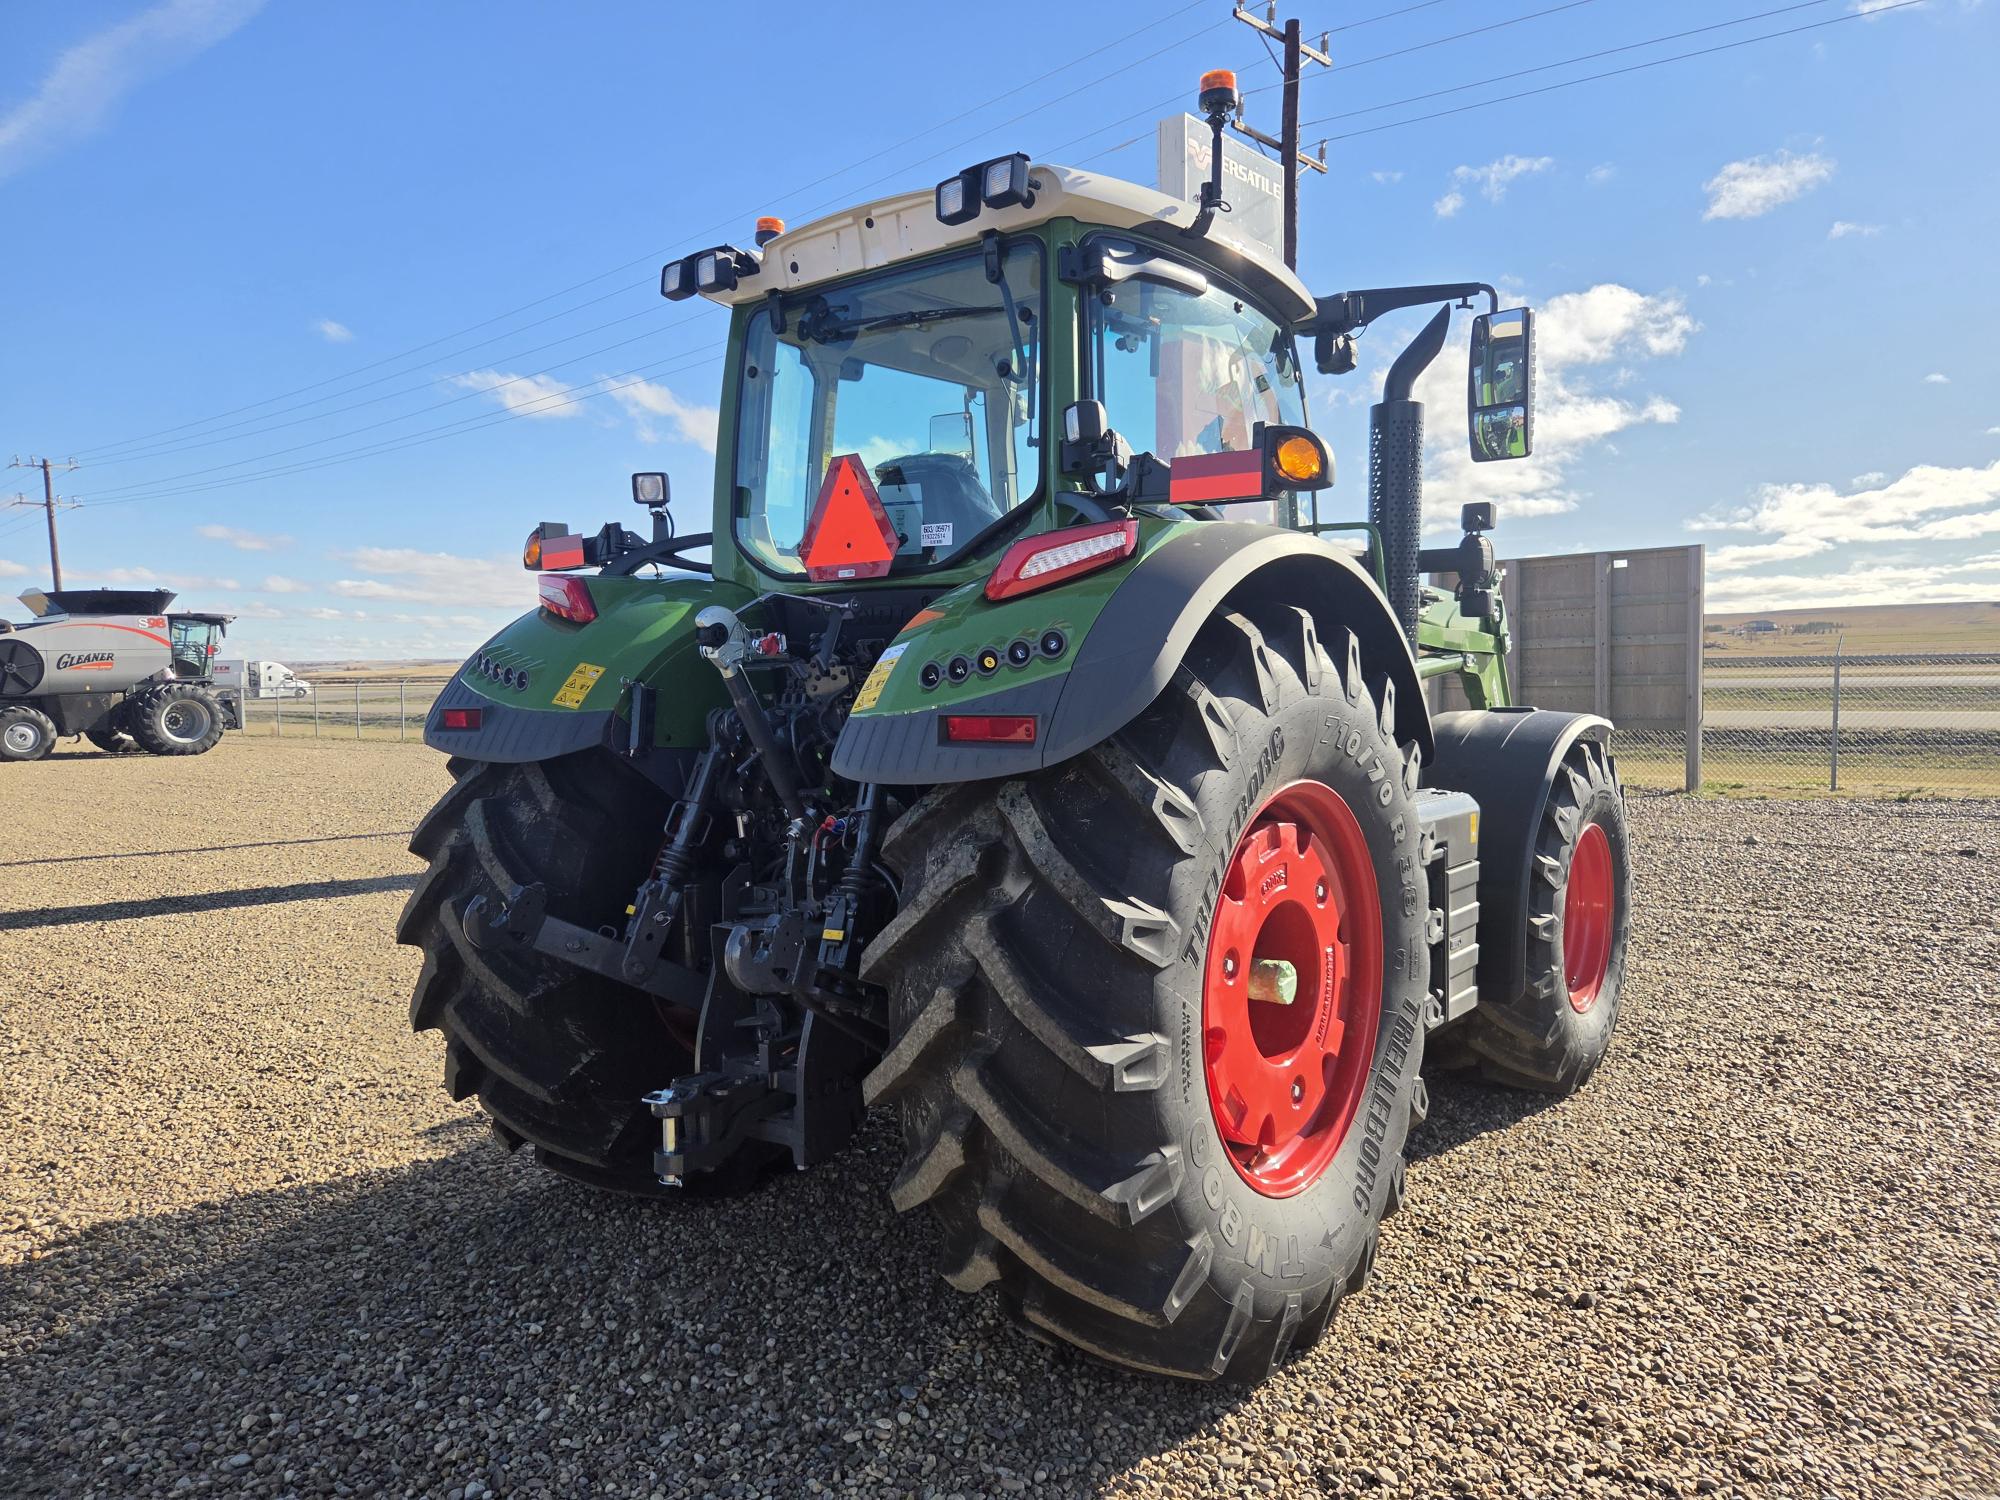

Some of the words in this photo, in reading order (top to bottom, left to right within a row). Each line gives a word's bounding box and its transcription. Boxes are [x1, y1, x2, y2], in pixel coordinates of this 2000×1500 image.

[1219, 154, 1281, 200] ERSATILE
[56, 652, 115, 670] GLEANER
[137, 616, 167, 629] S98
[1320, 715, 1394, 807] 710/70
[1182, 726, 1286, 970] TRELLEBORG
[1352, 998, 1422, 1217] TRELLEBORG
[1189, 1117, 1306, 1279] TM800
